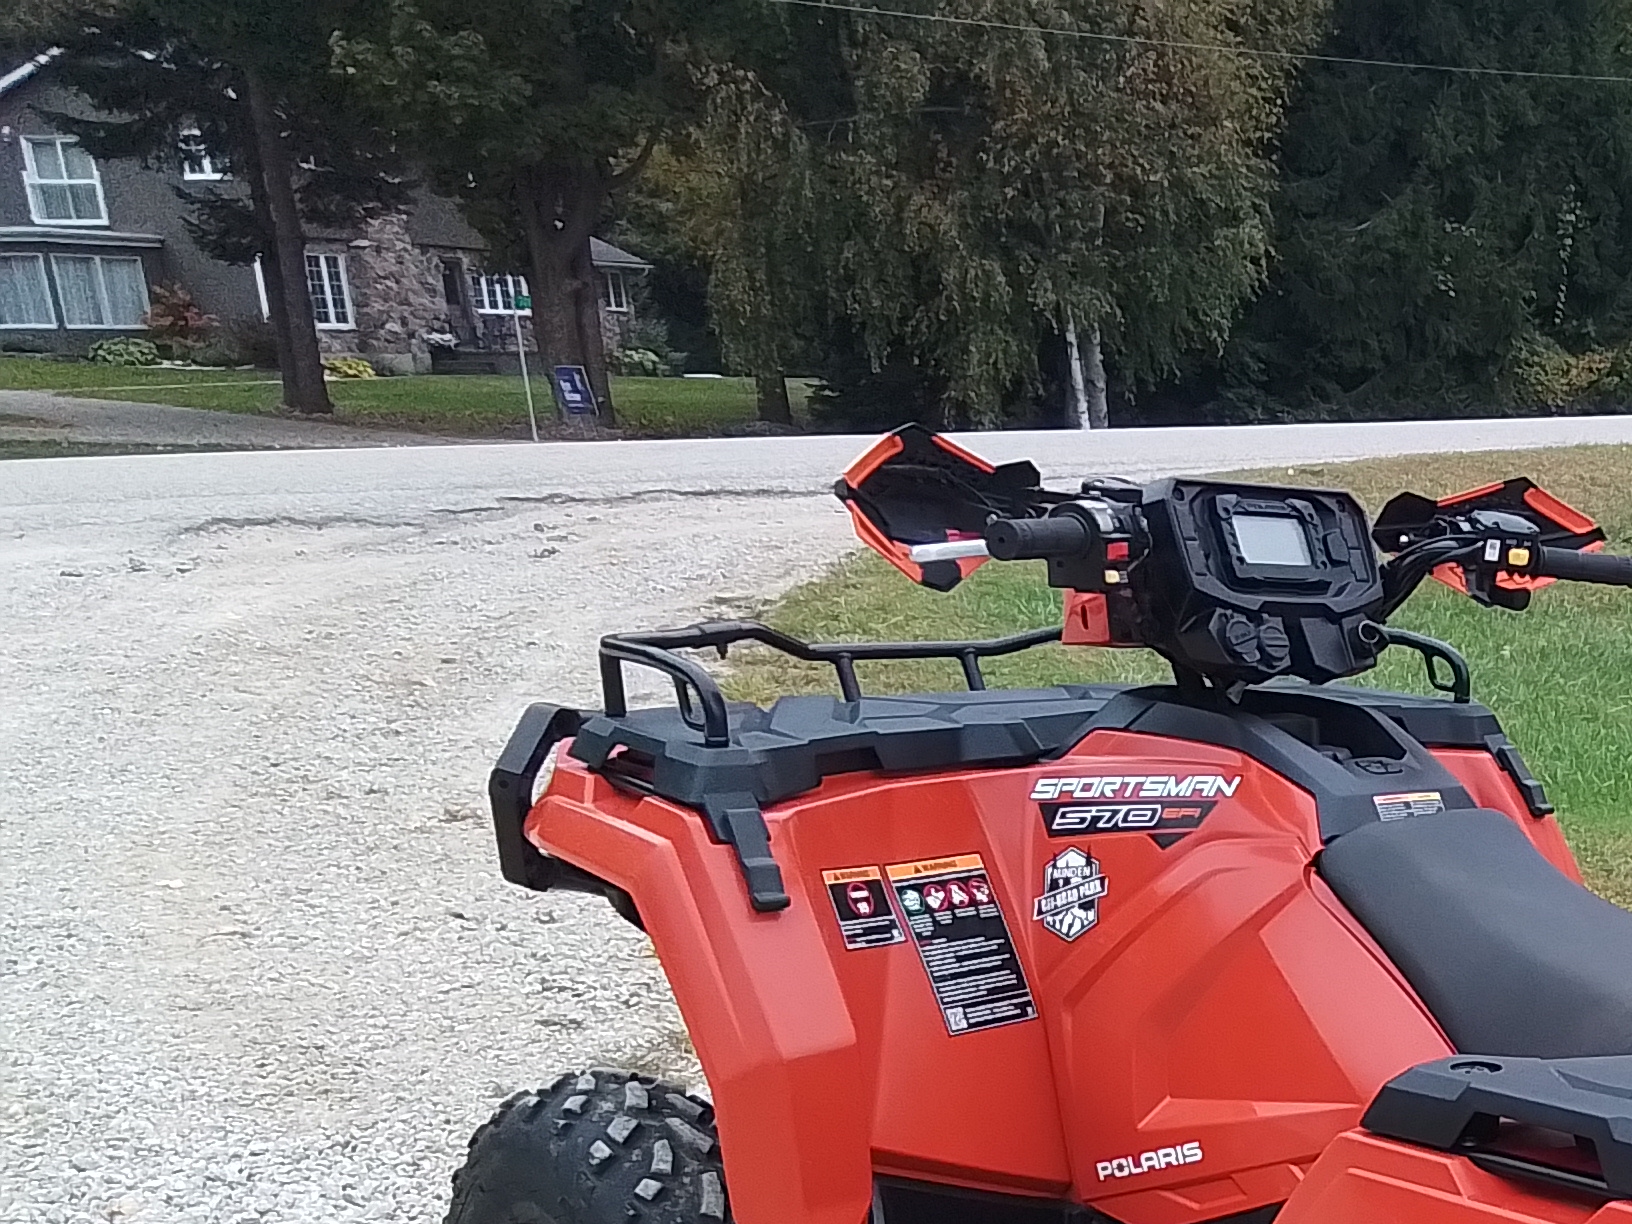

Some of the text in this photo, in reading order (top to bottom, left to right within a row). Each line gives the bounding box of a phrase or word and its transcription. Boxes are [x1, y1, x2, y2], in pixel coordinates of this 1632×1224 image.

[1030, 776, 1241, 799] SPORTSMAN
[1052, 804, 1161, 829] 570
[1096, 1141, 1203, 1181] POLARIS
